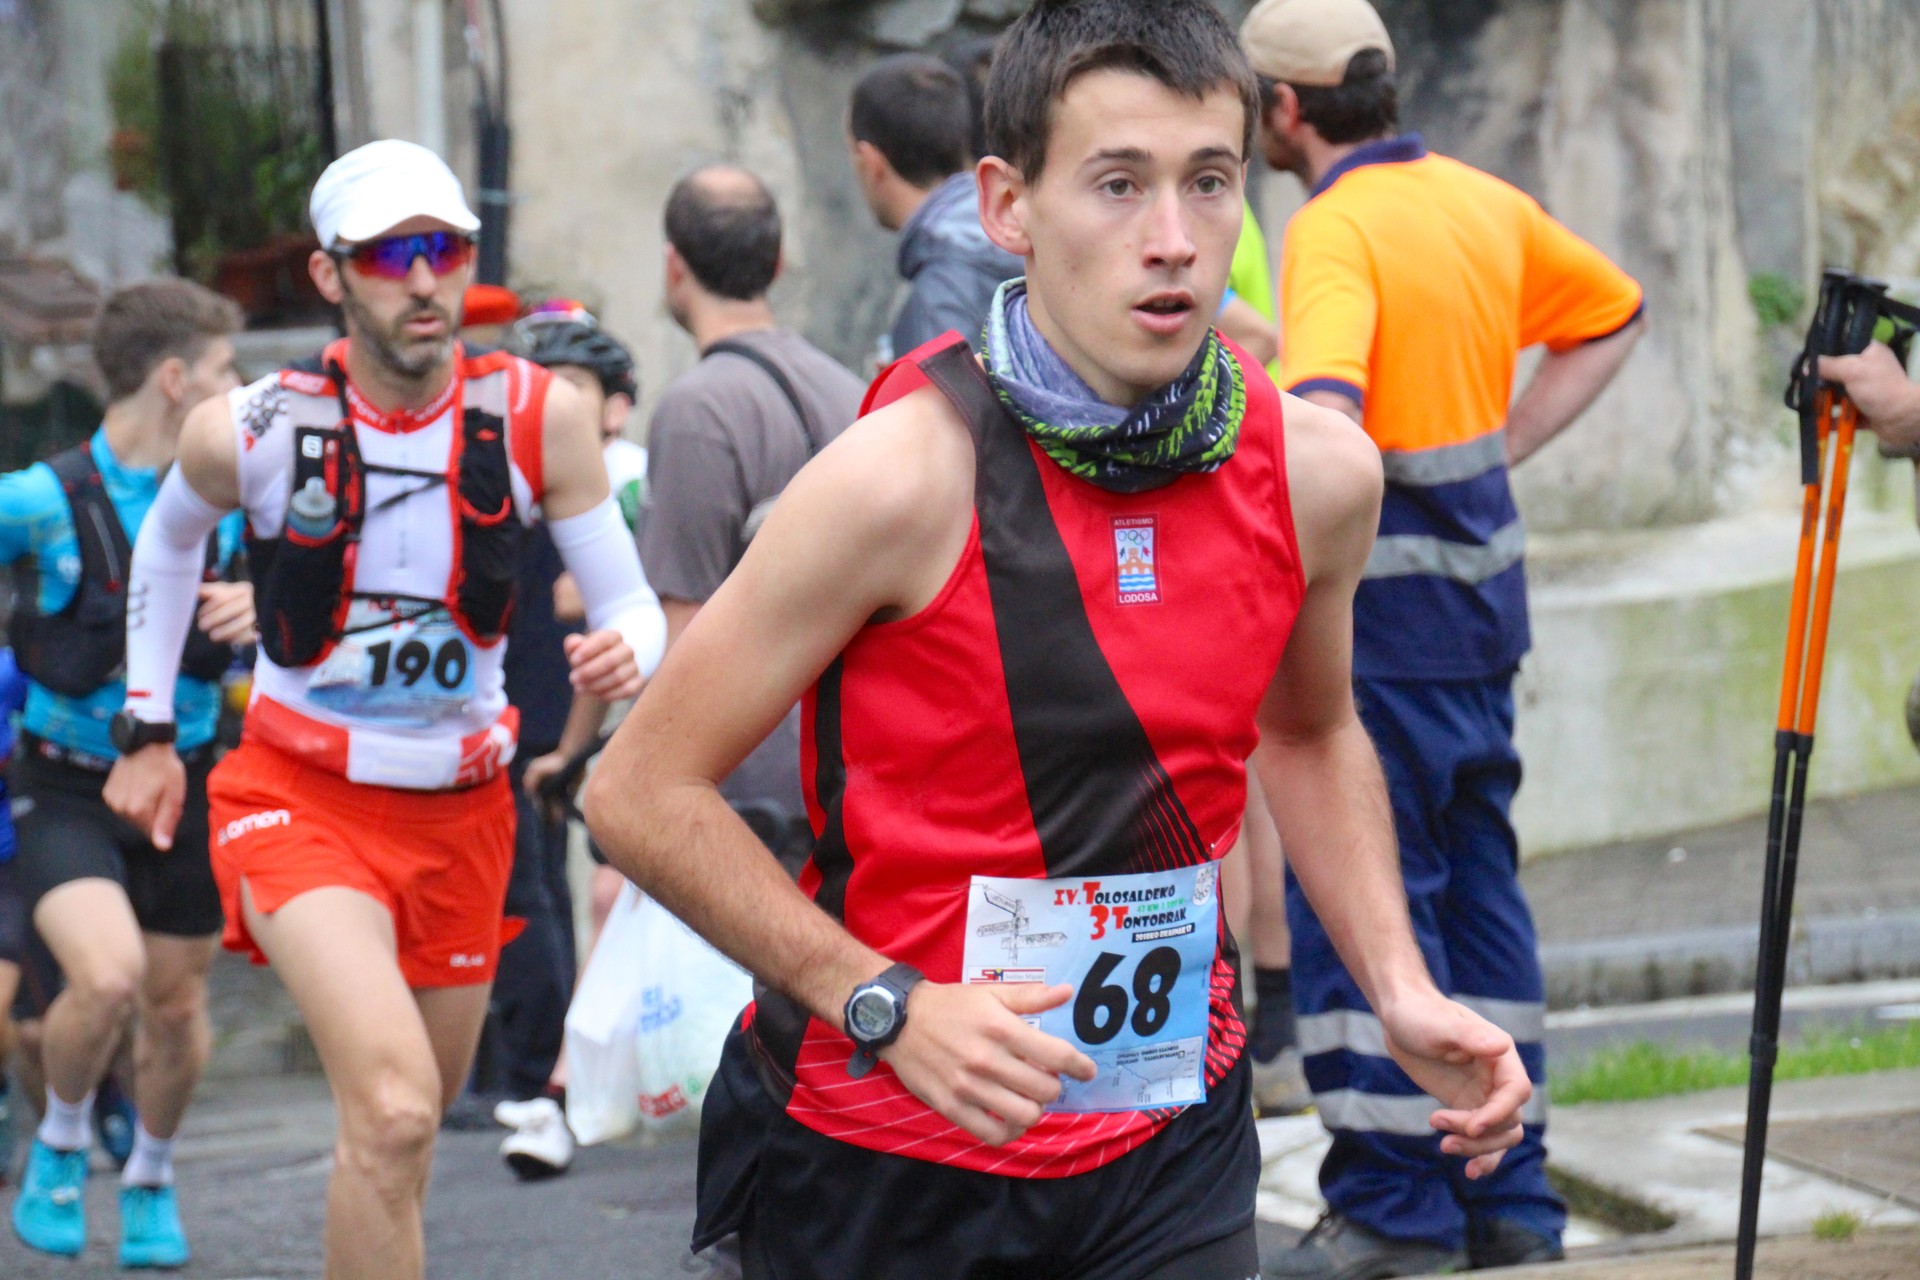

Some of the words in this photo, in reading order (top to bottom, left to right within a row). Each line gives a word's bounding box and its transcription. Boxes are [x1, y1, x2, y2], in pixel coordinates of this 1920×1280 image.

[1114, 518, 1153, 526] ATLETISMO
[1119, 592, 1158, 603] LODOSA
[367, 638, 467, 689] 190
[1054, 889, 1081, 906] IV.
[1082, 881, 1176, 904] TOLOSALDEKO
[1089, 904, 1110, 940] 3
[1111, 906, 1187, 930] TONTORRAK
[1072, 946, 1182, 1045] 68
